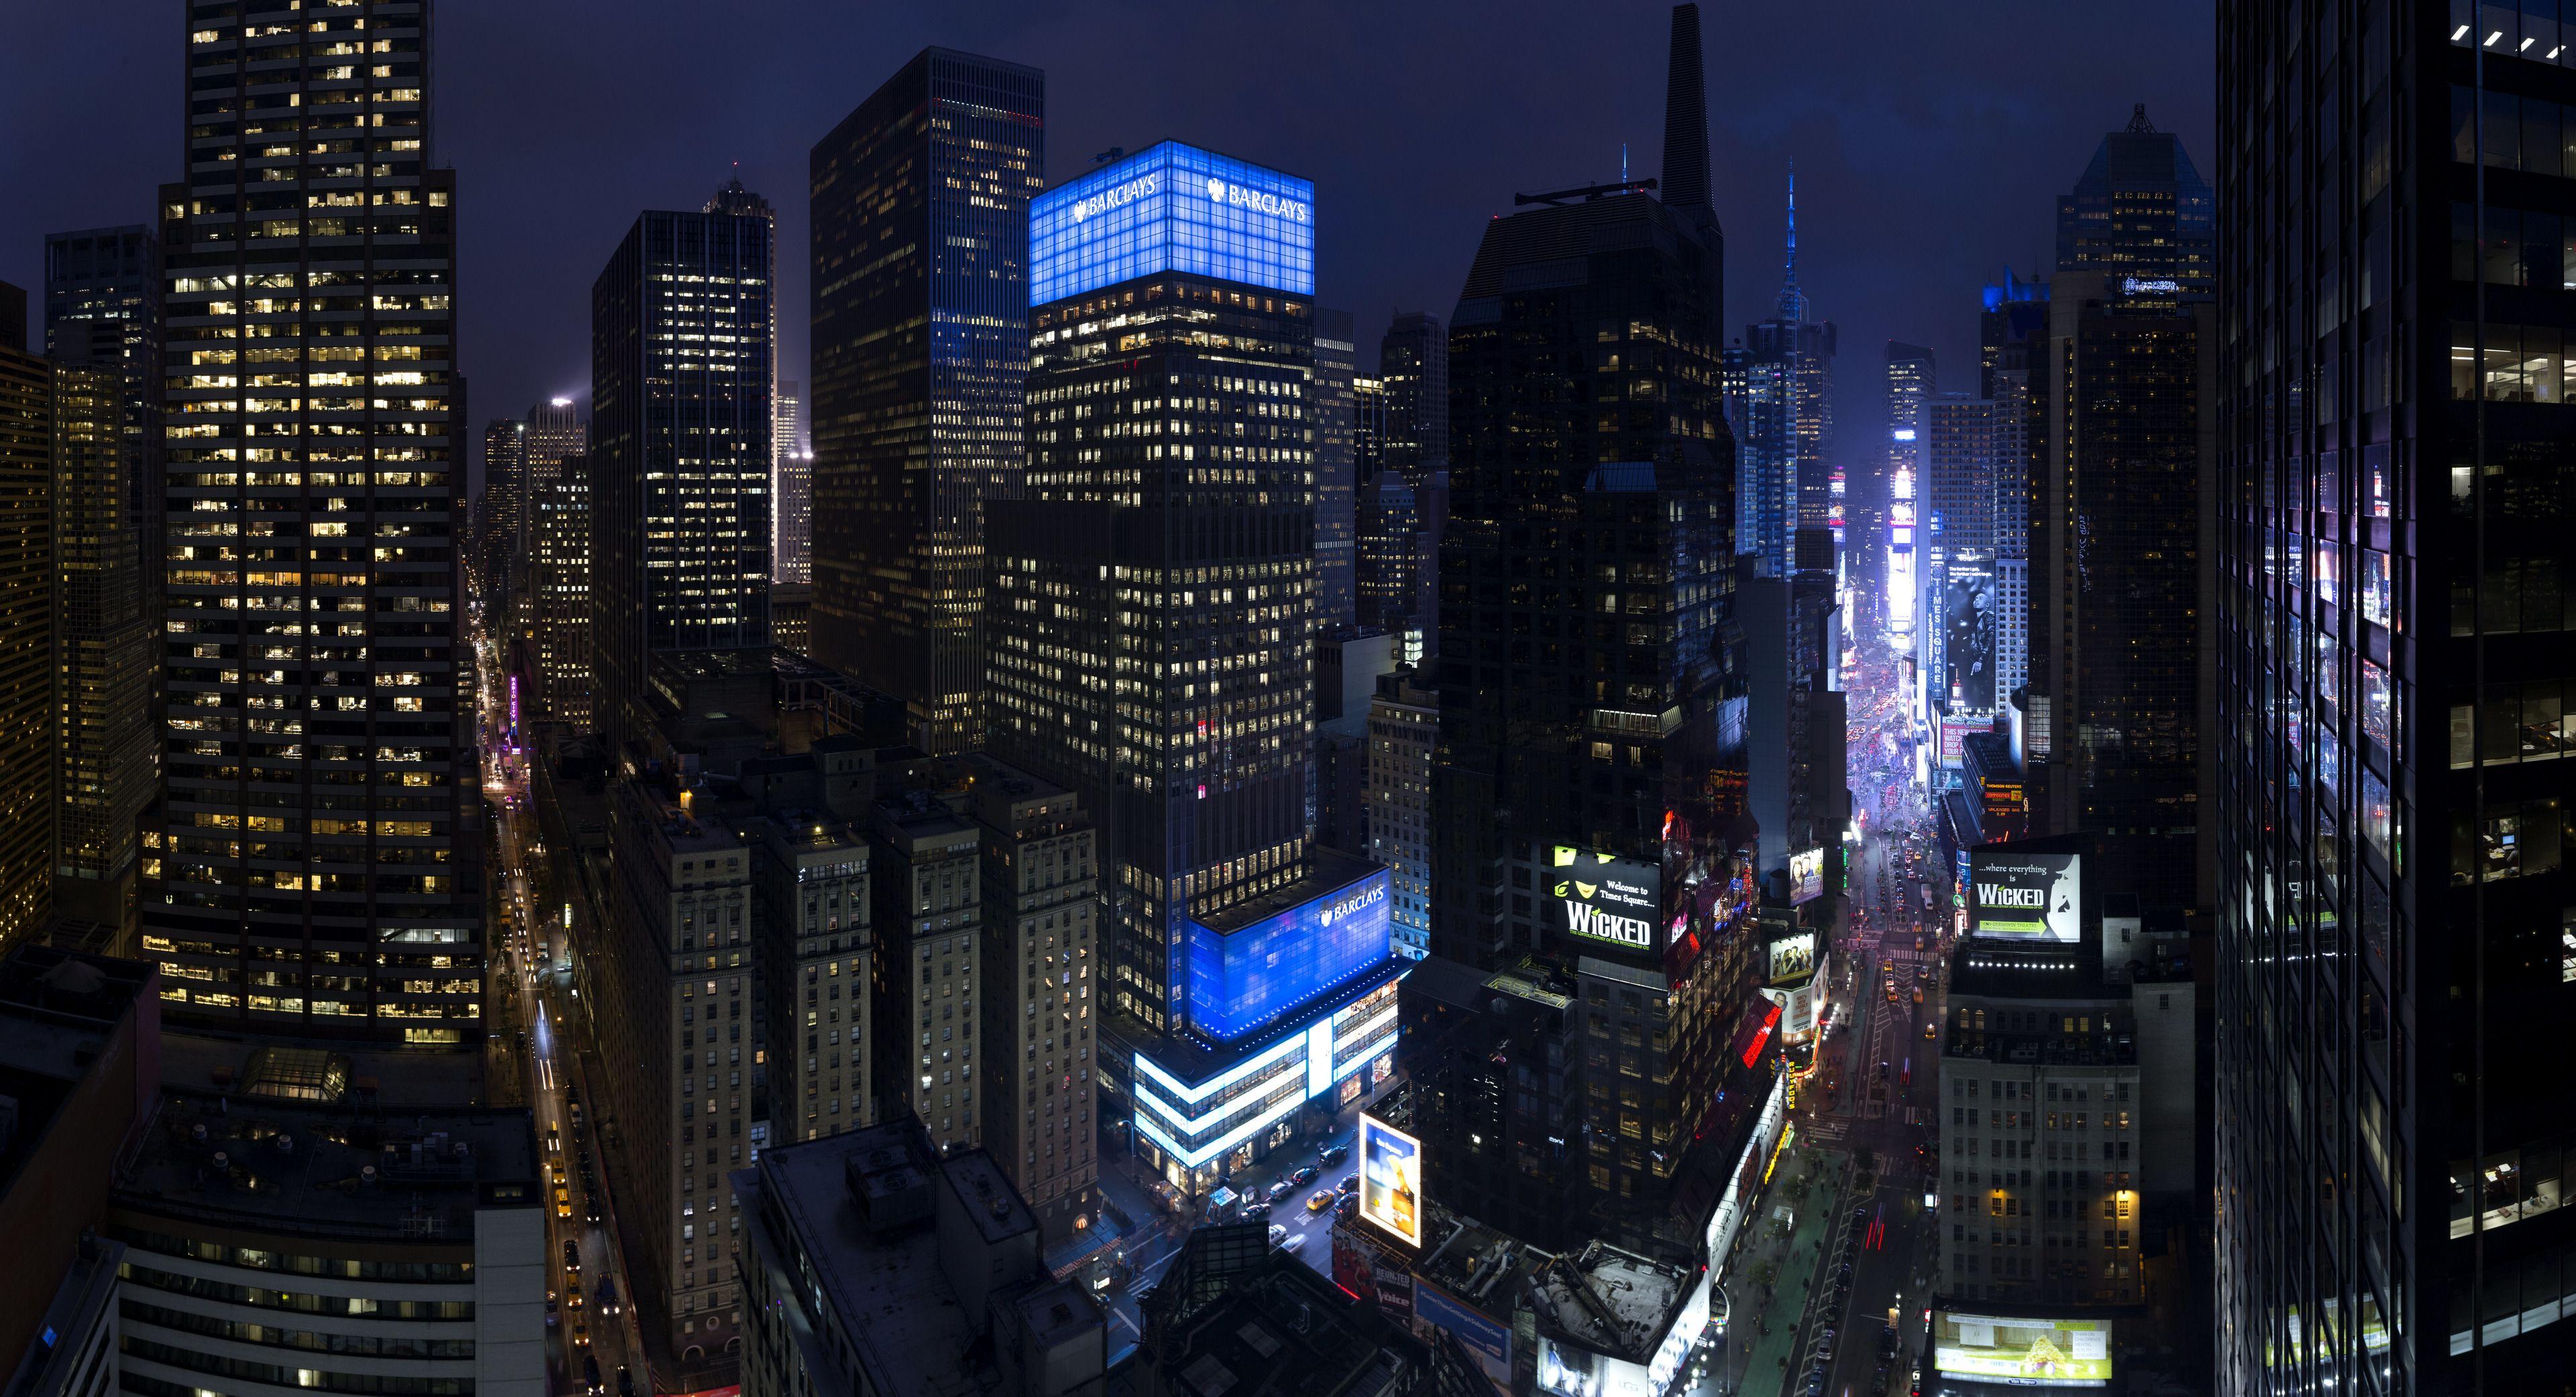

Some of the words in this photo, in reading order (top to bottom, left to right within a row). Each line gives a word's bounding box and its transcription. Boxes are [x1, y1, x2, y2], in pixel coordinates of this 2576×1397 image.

[1089, 173, 1156, 215] BARCLAYS
[1228, 185, 1305, 221] BARCLAYS
[1933, 578, 1942, 623] TIMES
[1933, 627, 1942, 684] SQUARE
[2008, 864, 2047, 875] everything
[1600, 890, 1621, 901] Times
[1607, 880, 1639, 894] Welcome
[1640, 887, 1648, 895] to
[1334, 886, 1384, 921] BARCLAYS
[1577, 931, 1593, 939] UNTOLD
[1593, 933, 1605, 941] STORY
[1619, 940, 1637, 948] WITCHES
[1376, 1288, 1409, 1306] Voice
[1618, 1380, 1639, 1392] UGG
